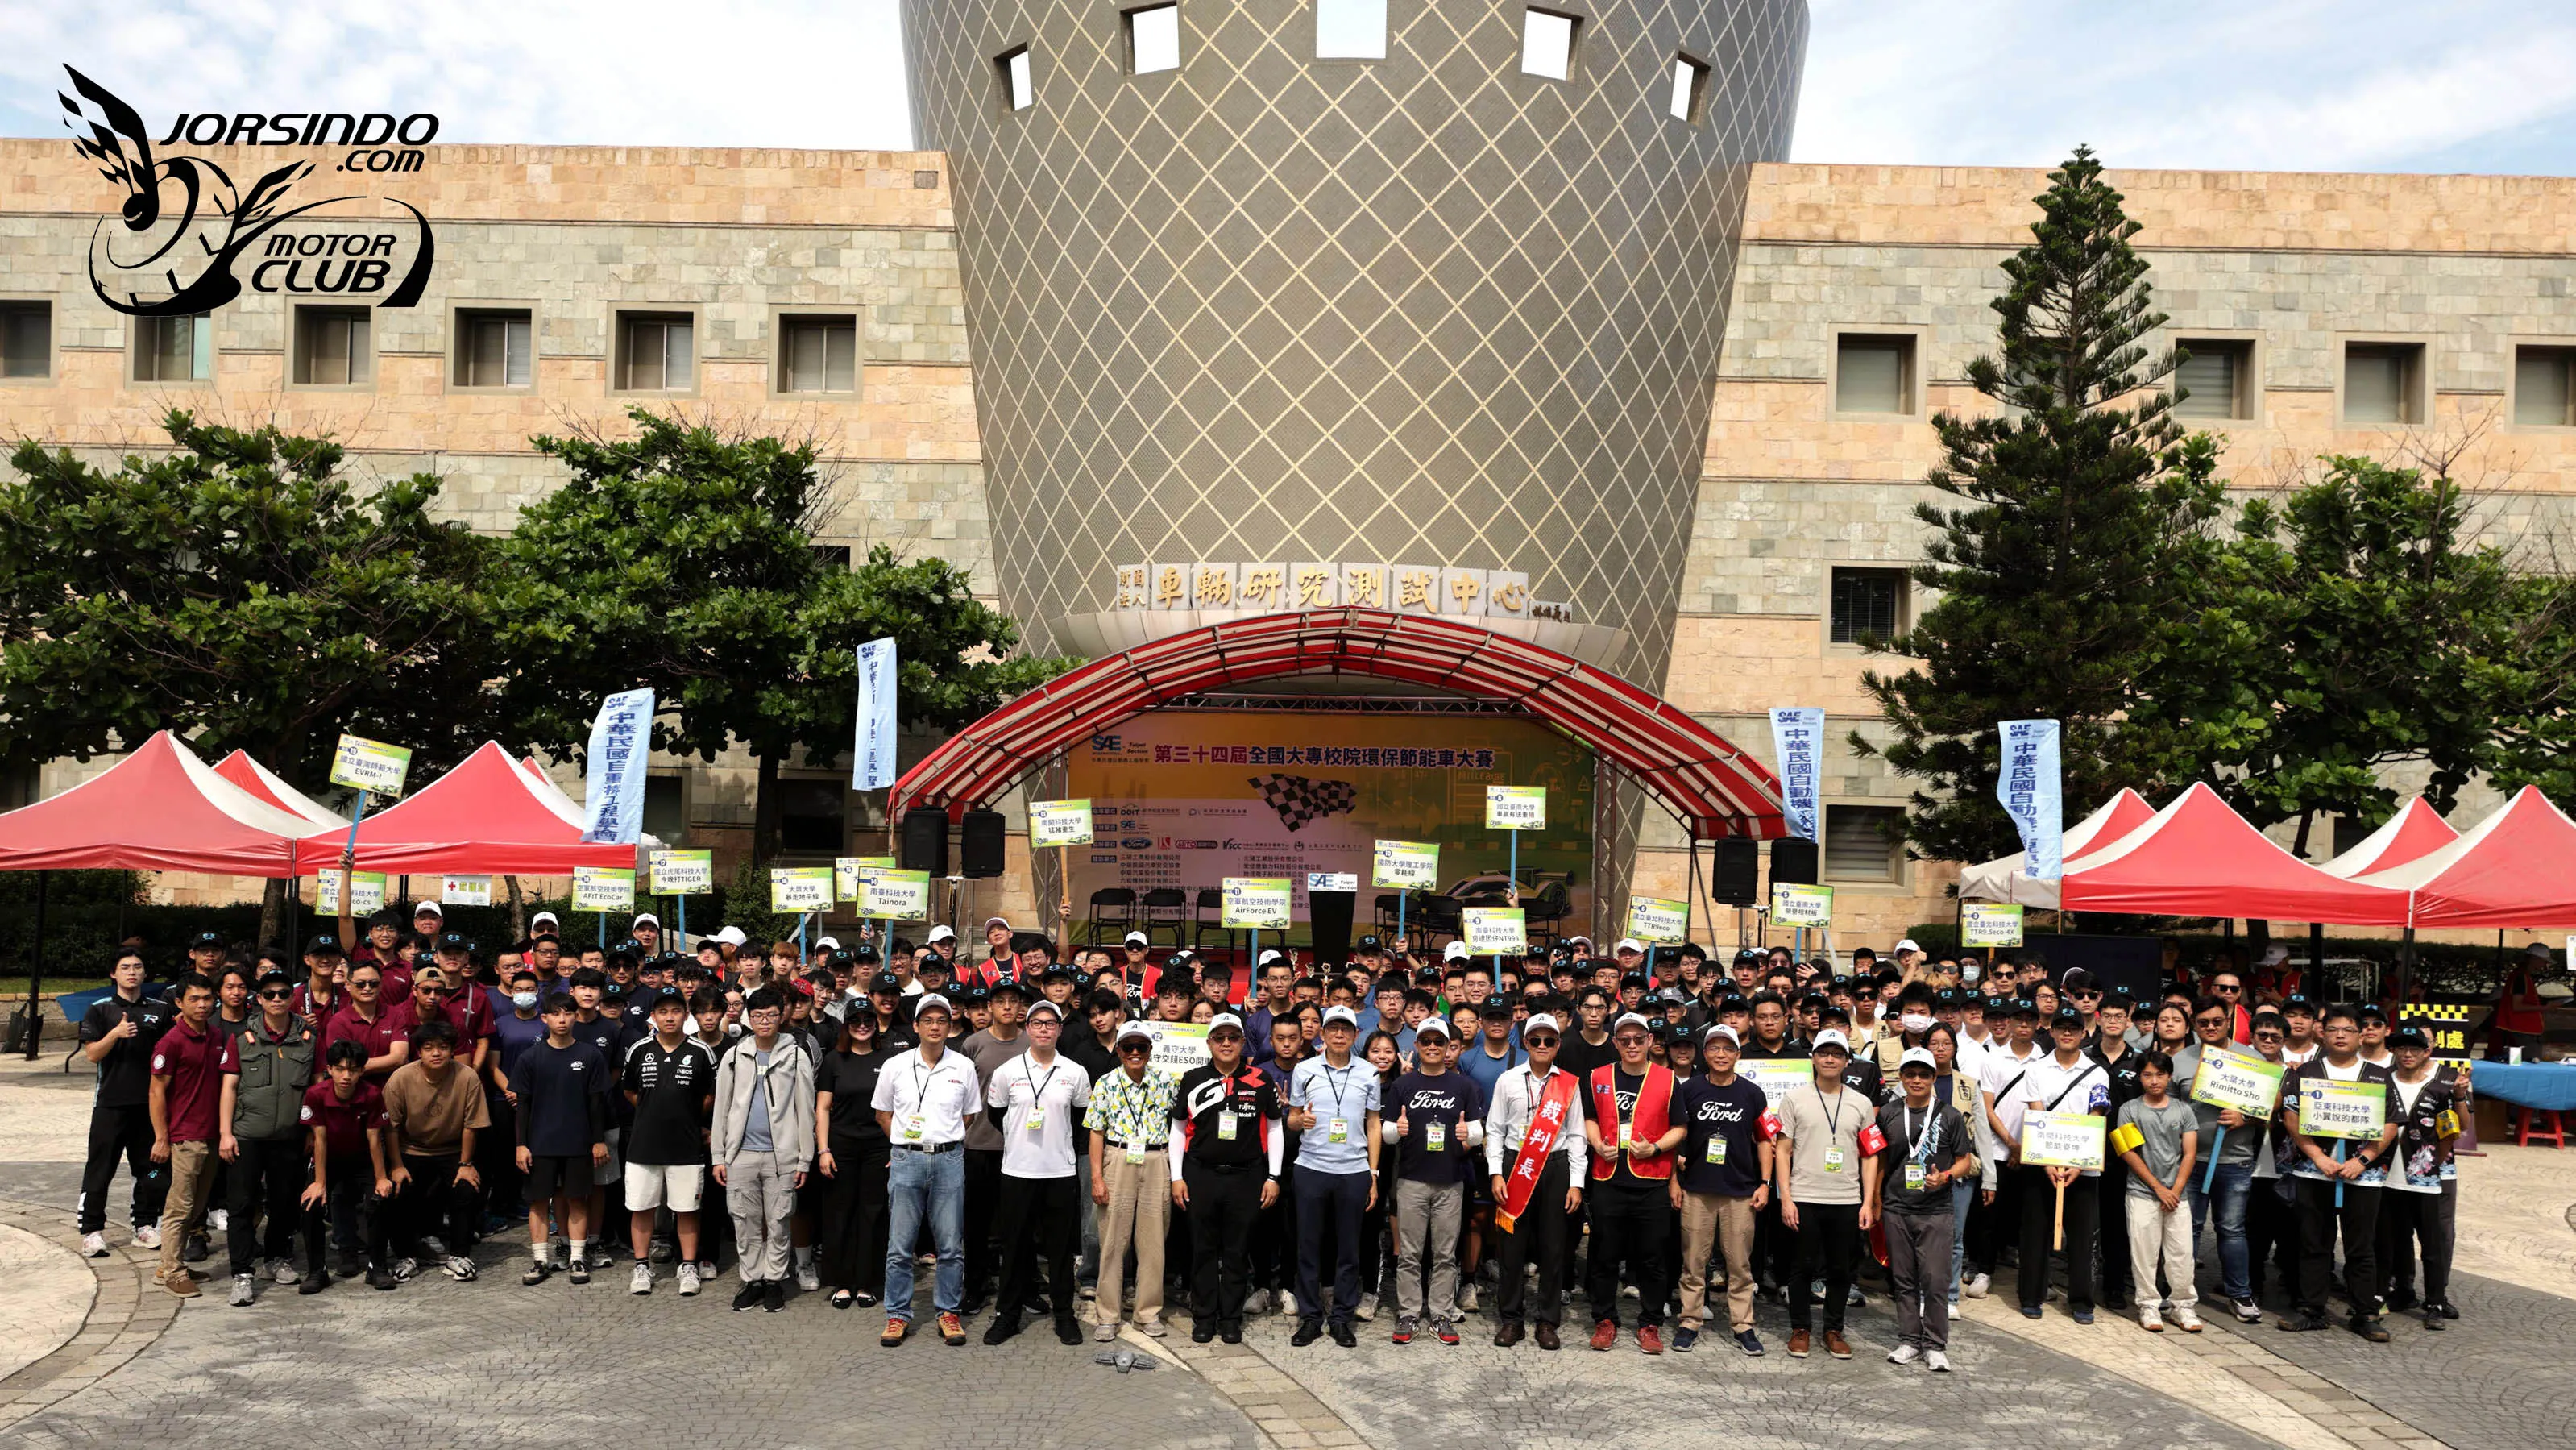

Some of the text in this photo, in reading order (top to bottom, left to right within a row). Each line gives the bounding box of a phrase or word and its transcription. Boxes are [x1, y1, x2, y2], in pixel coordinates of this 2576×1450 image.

[1156, 566, 1525, 614] 車輛研究測試中心
[1092, 735, 1122, 751] SAE
[1154, 744, 1494, 768] 第三十四屆全國大專校院環保節能車大賽
[1309, 874, 1334, 887] SAE
[599, 893, 623, 901] EcoCar
[878, 898, 907, 906] Tainora
[1163, 1044, 1197, 1054] 義守大學
[2209, 1080, 2261, 1101] Rimitto Sho
[1410, 1090, 1455, 1110] Ford
[2313, 1101, 2371, 1113] 亞東科技大學
[1697, 1101, 1744, 1122] Ford
[1517, 1099, 1562, 1180] 裁判長
